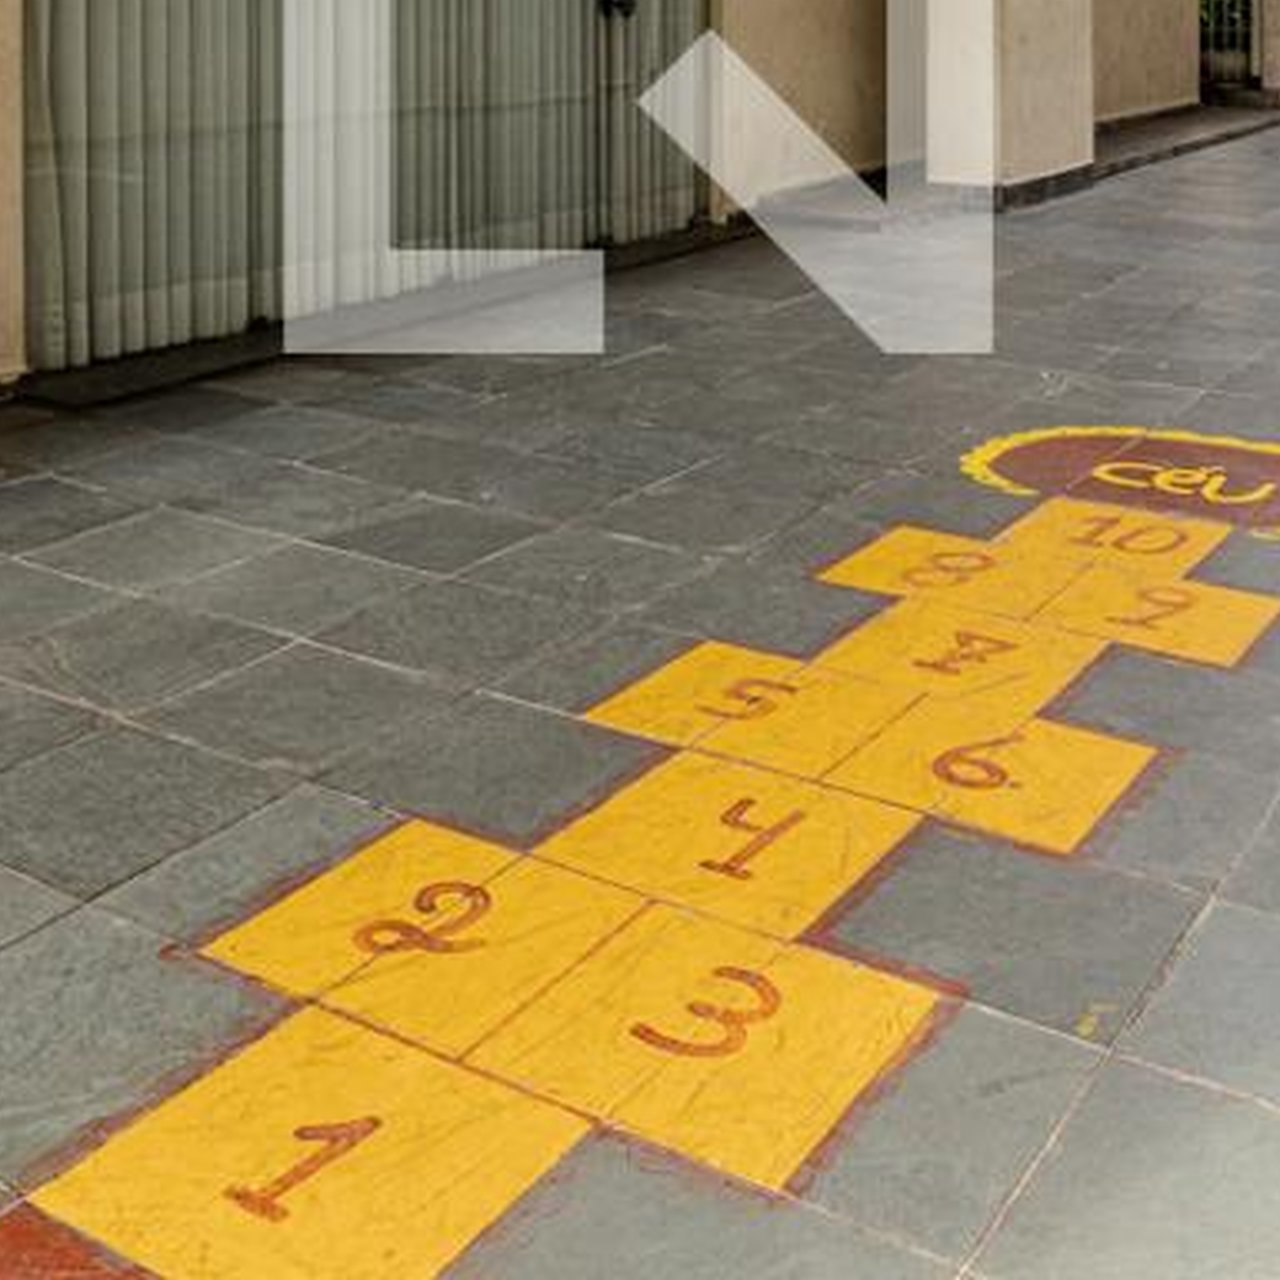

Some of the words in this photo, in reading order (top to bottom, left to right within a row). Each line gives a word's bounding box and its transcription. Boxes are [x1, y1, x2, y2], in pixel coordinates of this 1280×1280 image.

[902, 552, 995, 588] 8
[1068, 516, 1188, 554] 10
[694, 677, 800, 720] 5
[698, 797, 807, 881] 4
[353, 881, 490, 956] 2
[628, 966, 782, 1058] 3
[224, 1115, 382, 1222] 1
